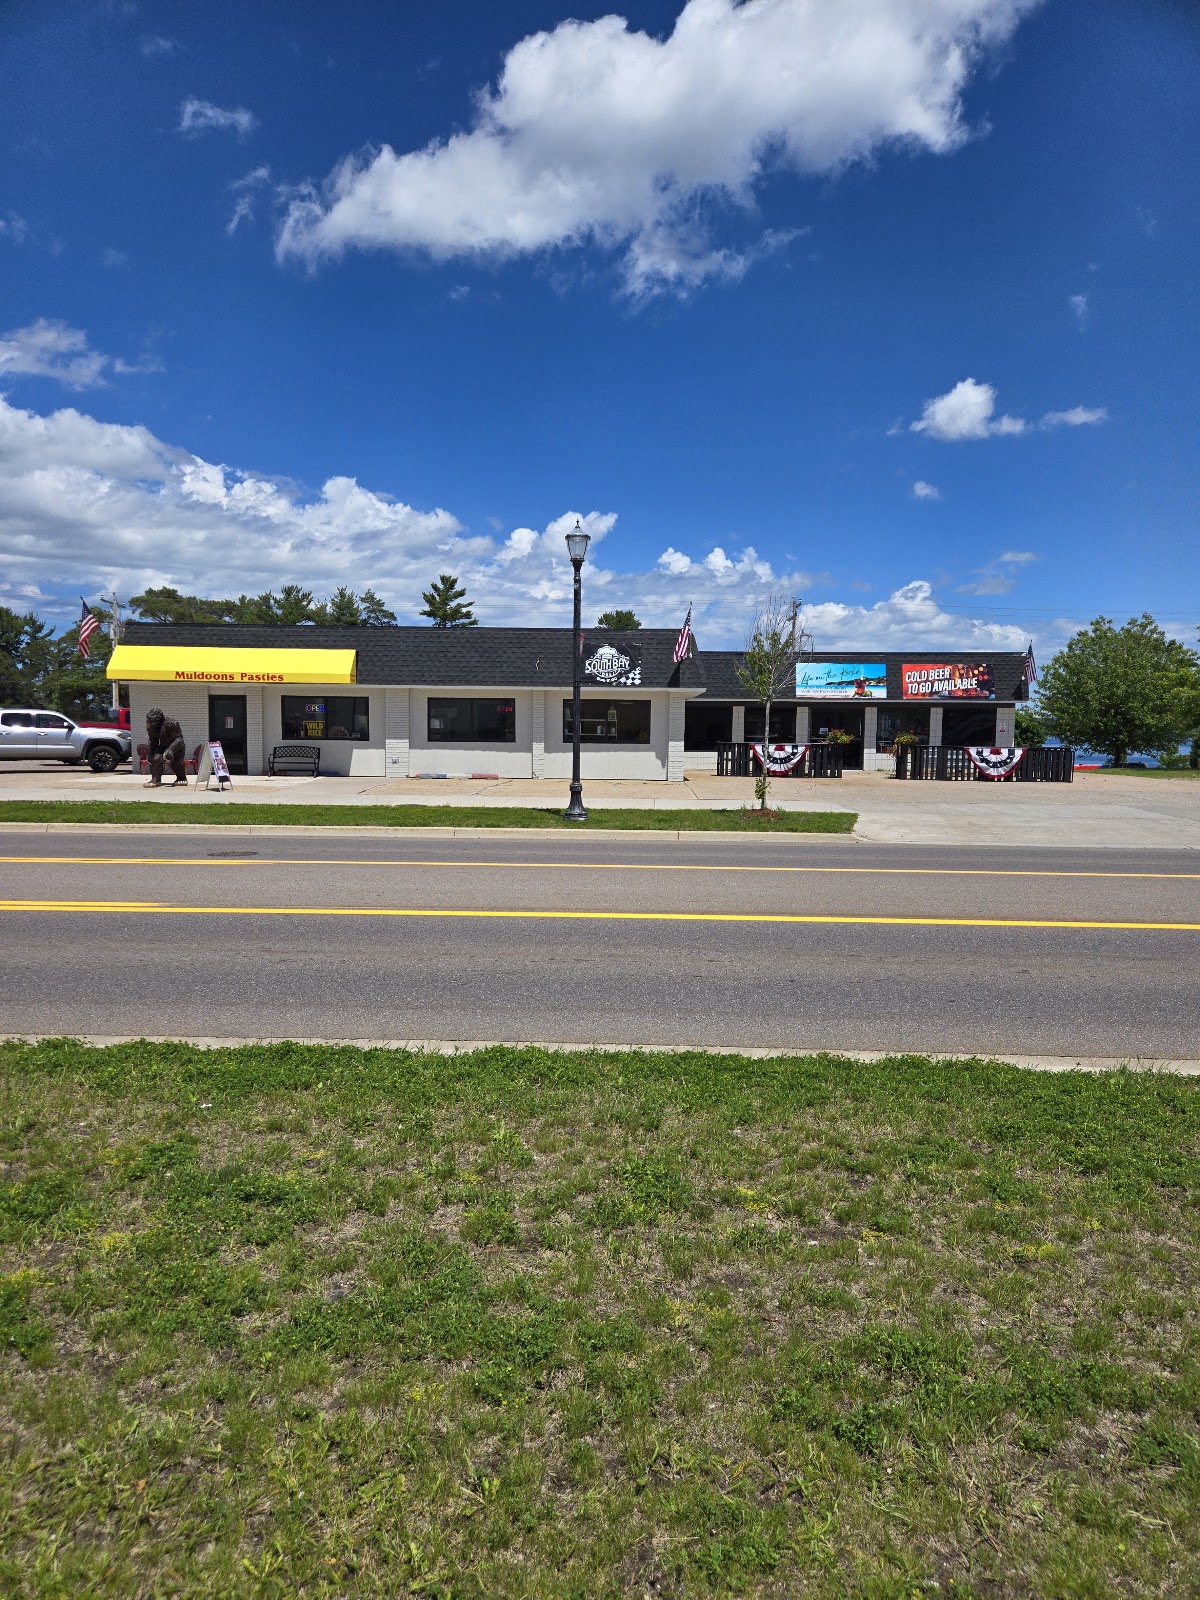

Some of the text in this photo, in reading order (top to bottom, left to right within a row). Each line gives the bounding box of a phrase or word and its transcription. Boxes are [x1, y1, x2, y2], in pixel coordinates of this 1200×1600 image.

[585, 658, 630, 672] SOUTH BAY
[174, 671, 284, 681] Muldoons Pasties
[905, 668, 950, 682] COLD BEER
[908, 677, 978, 694] TO GO AVAILABLE
[306, 722, 324, 730] WILD
